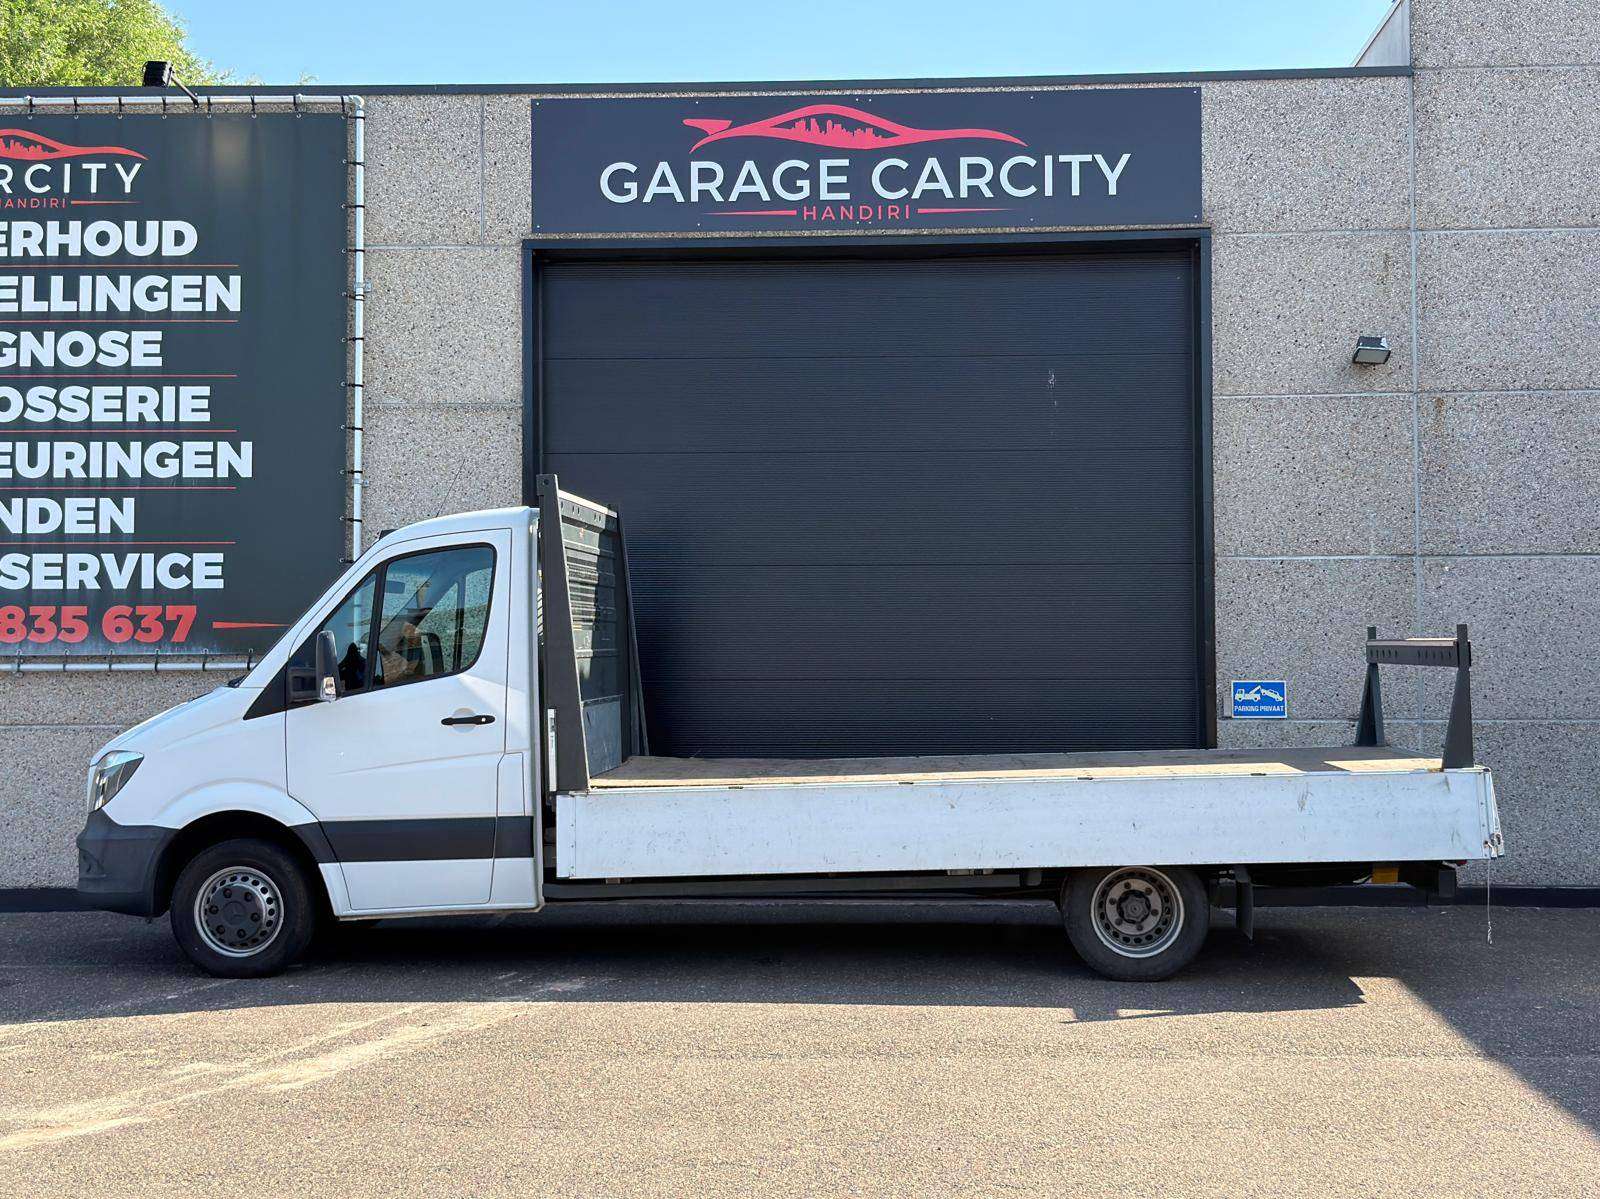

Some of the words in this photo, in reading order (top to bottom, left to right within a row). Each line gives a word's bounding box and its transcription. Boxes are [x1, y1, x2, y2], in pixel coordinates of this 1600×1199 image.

[599, 159, 850, 203] GARAGE
[871, 153, 1131, 200] CARCITY
[0, 197, 67, 209] ANDIRI
[802, 204, 910, 221] HANDIRI
[0, 220, 198, 257] RHOUD
[0, 275, 241, 312] ELLINGEN
[0, 385, 211, 423] OSSERIE
[0, 497, 135, 534] NDEN
[0, 552, 224, 590] SERVICE
[0, 605, 89, 643] 835
[102, 605, 197, 643] 637
